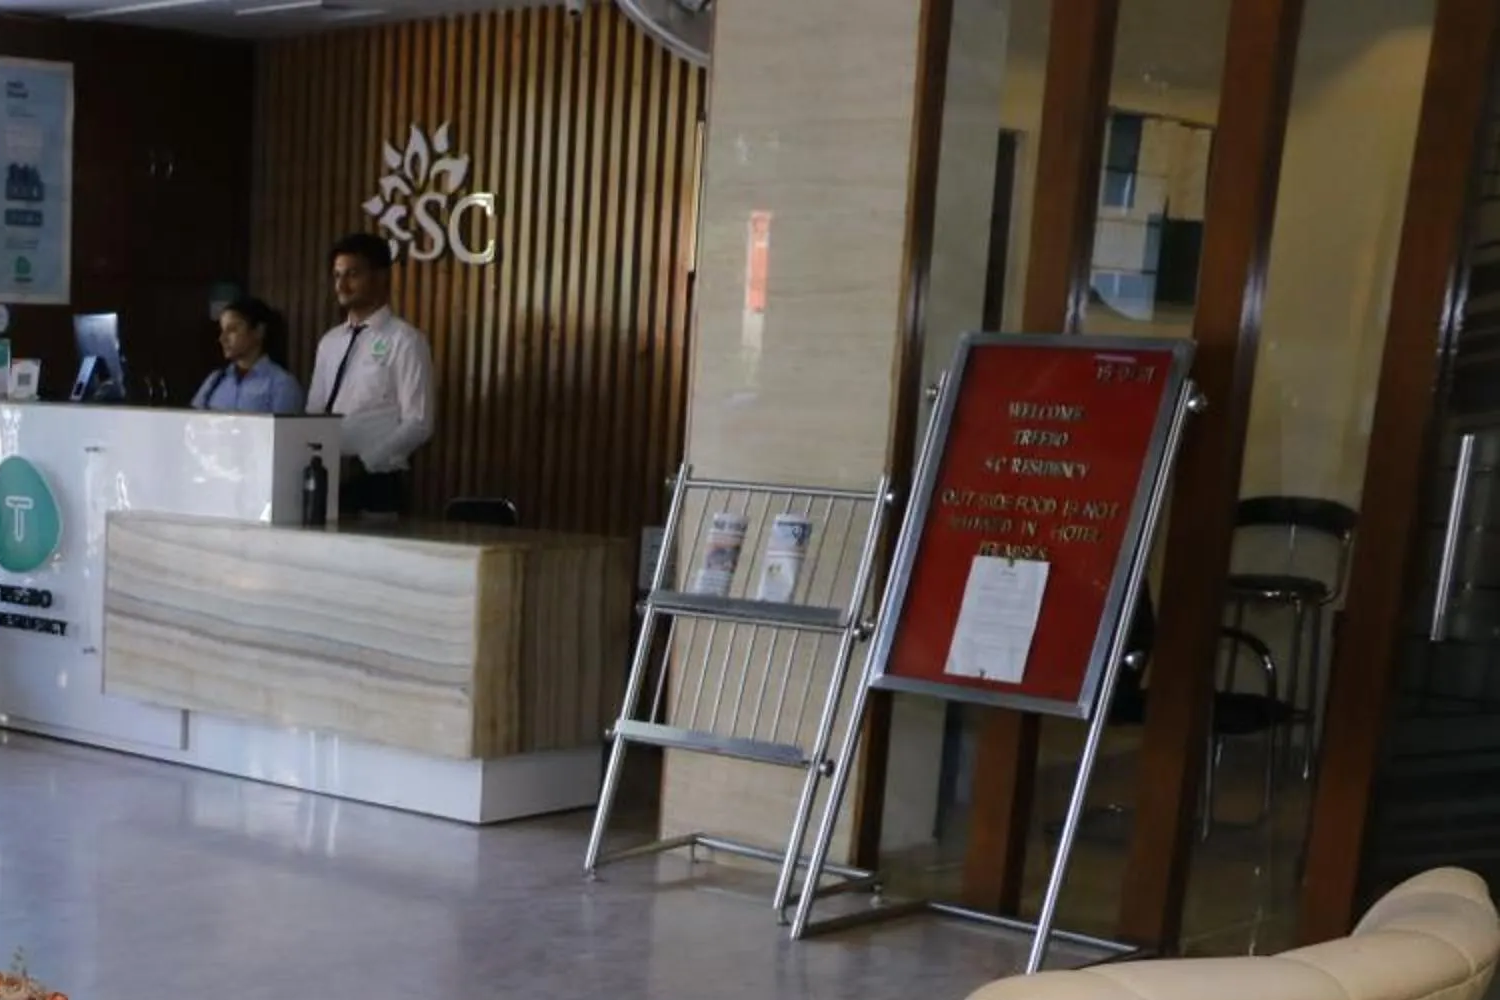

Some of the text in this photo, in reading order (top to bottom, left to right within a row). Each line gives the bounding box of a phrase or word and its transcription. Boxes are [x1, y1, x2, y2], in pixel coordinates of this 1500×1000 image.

[408, 191, 495, 265] SC
[1008, 402, 1085, 420] WELCOME
[1014, 494, 1057, 513] FOOD
[1083, 500, 1119, 519] NOT
[1021, 519, 1038, 537] IN
